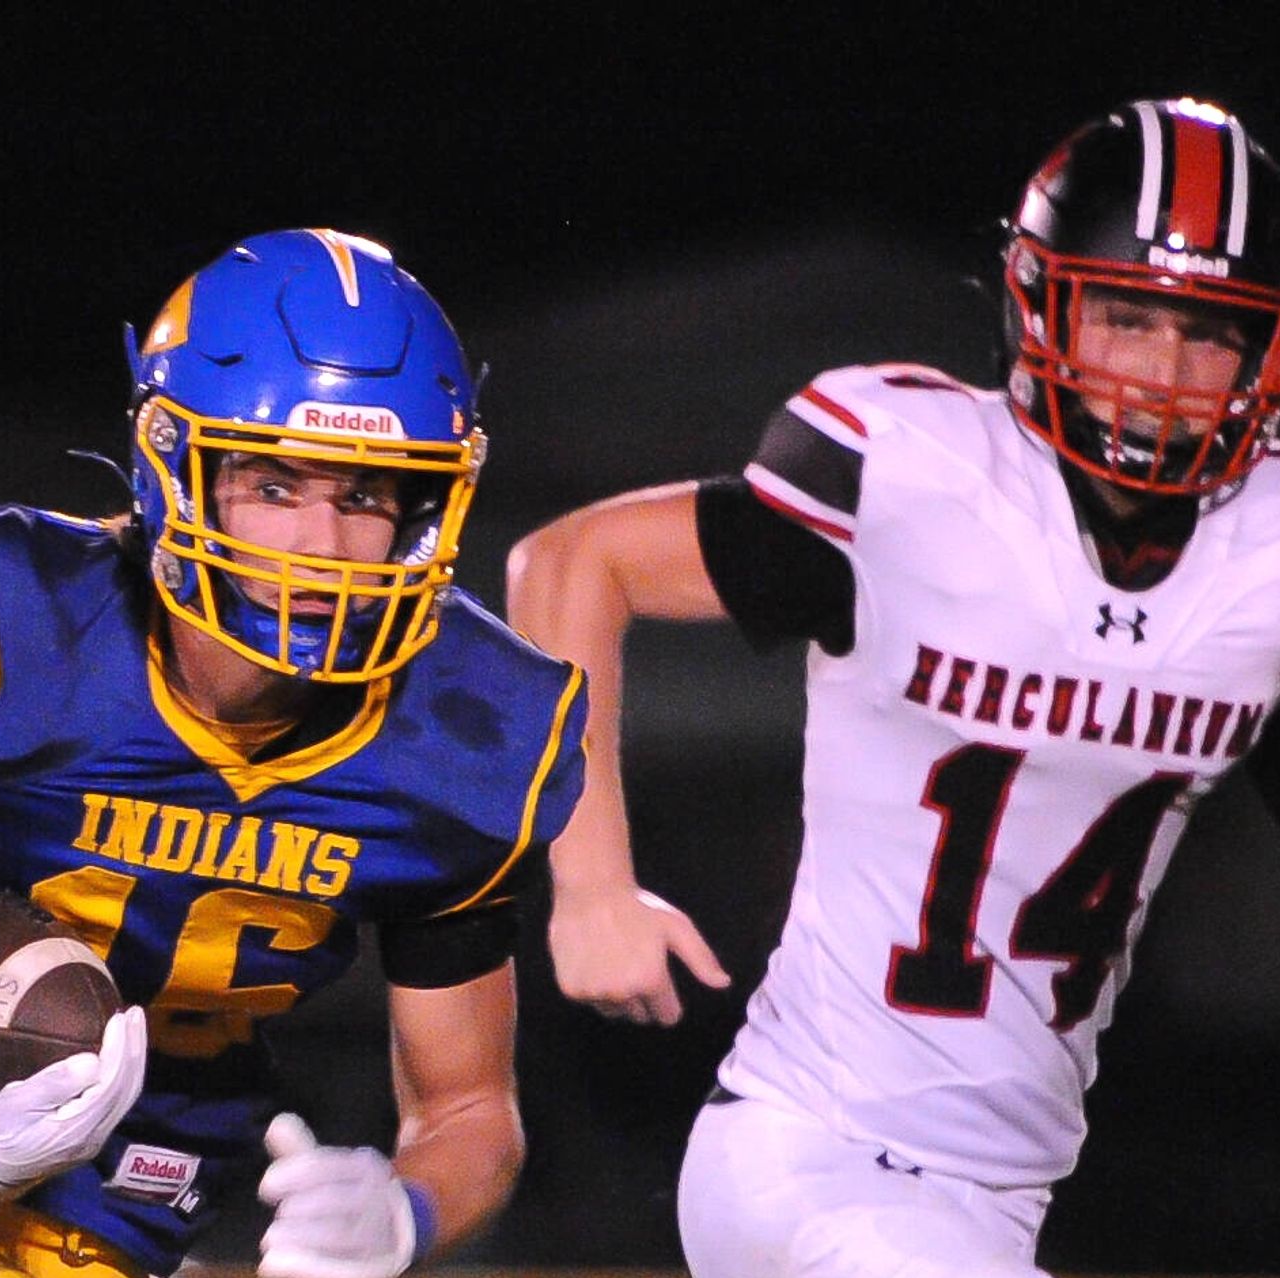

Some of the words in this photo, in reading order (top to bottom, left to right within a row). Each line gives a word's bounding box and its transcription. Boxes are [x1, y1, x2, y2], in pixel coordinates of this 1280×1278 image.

[305, 409, 393, 434] Riddell
[904, 642, 1264, 758] HERCULANEUM
[72, 793, 360, 897] INDIANS
[884, 741, 1196, 1033] 14
[129, 1156, 188, 1181] Riddell
